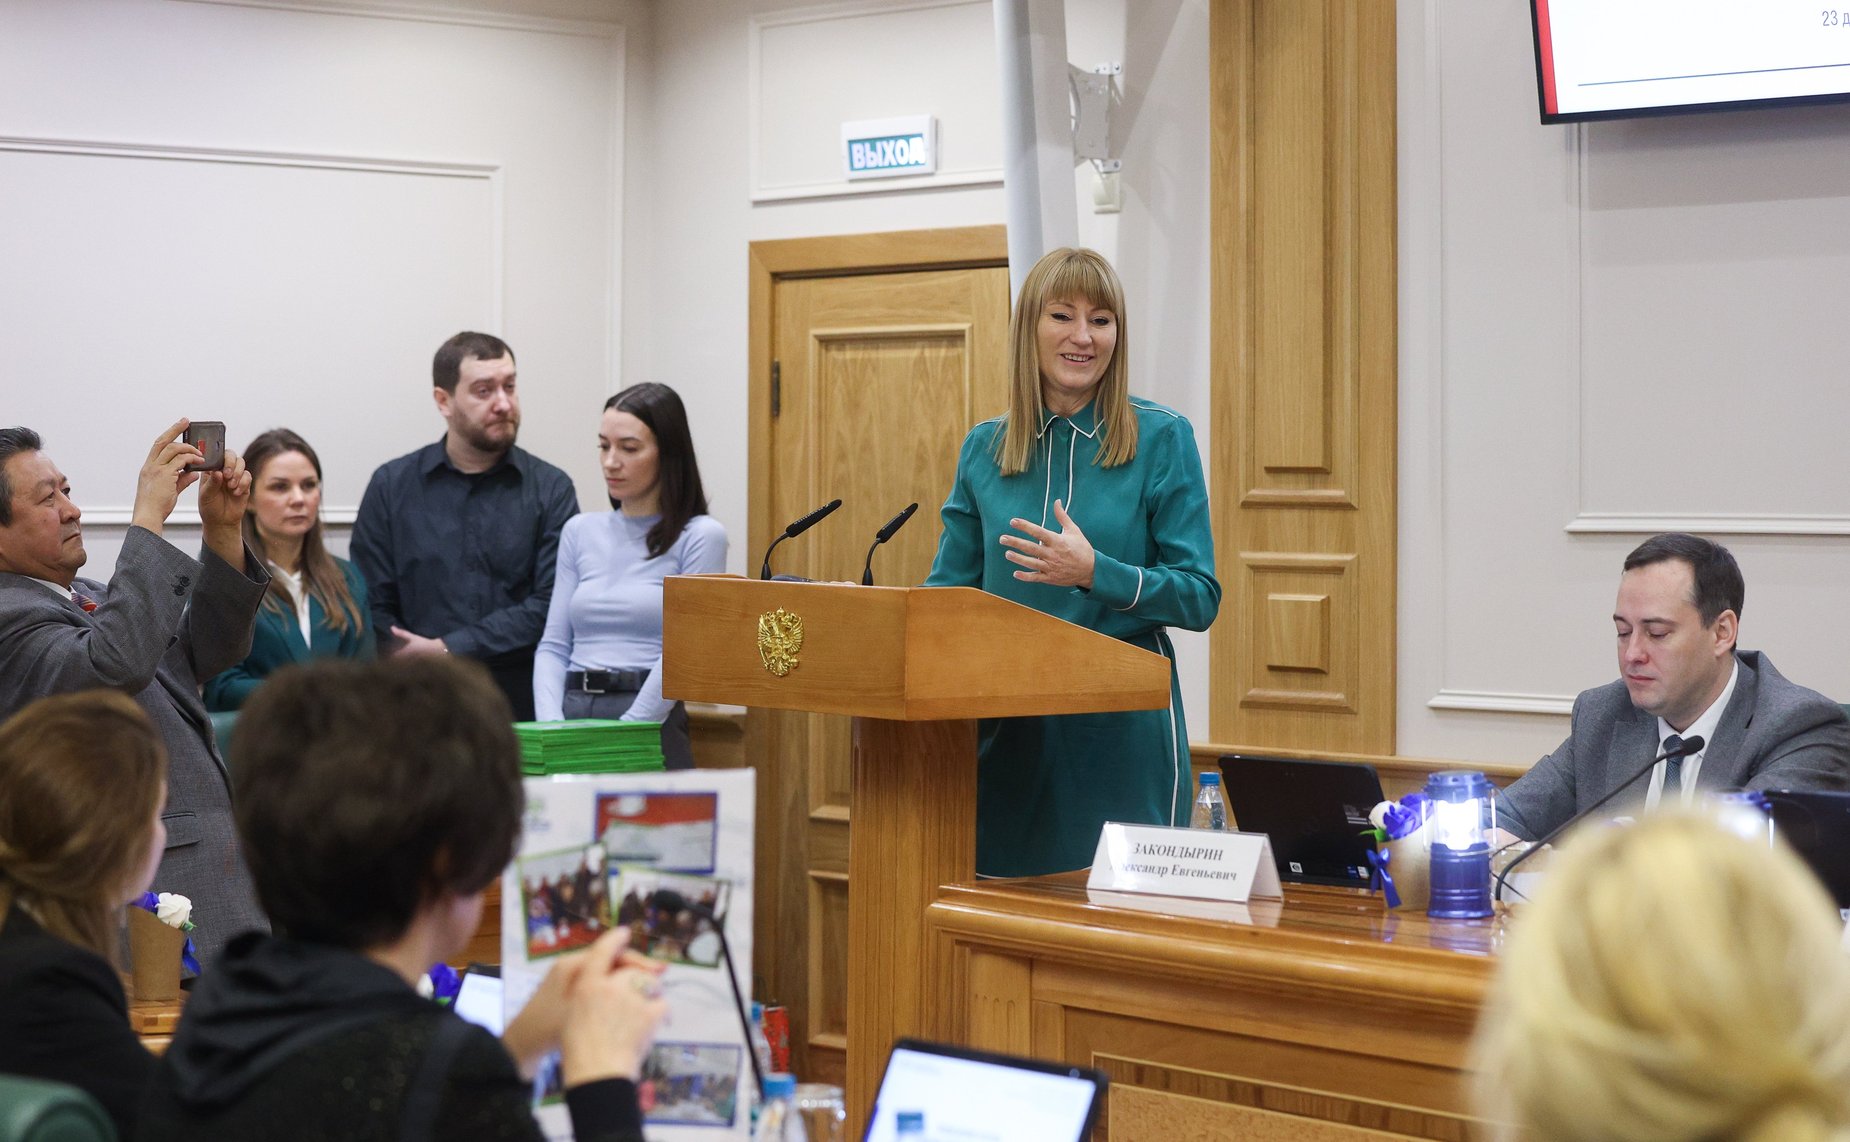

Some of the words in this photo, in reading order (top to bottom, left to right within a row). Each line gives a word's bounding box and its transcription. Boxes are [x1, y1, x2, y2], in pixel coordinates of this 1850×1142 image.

[1821, 10, 1838, 26] 23
[851, 137, 926, 169] ВЫХОД
[1132, 842, 1223, 861] ЗАКОНДЫРИН
[1109, 863, 1168, 878] ександр
[1171, 864, 1237, 881] Евгеньевич
